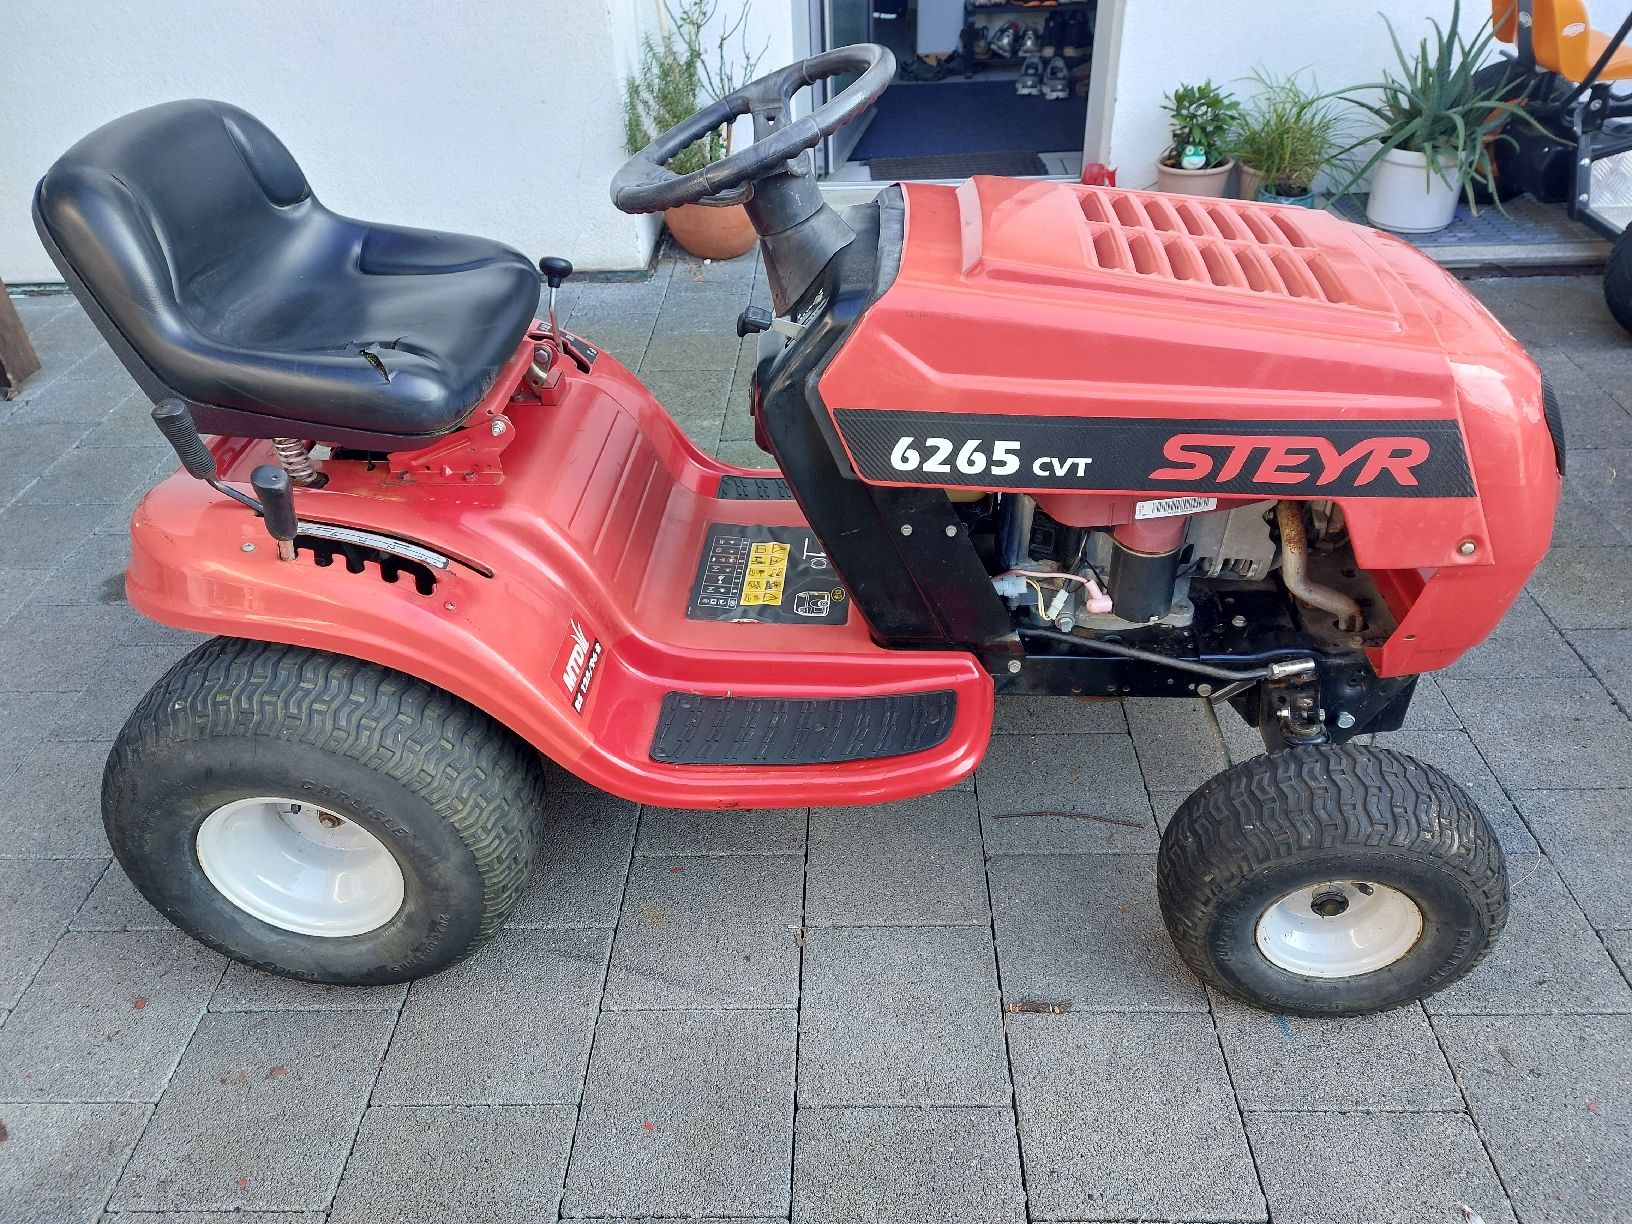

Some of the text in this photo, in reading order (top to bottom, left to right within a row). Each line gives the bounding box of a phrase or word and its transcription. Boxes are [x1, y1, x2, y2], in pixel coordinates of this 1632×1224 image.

[890, 436, 1092, 478] 6265 CVT
[1148, 433, 1431, 486] STEYR
[562, 643, 585, 693] MTD
[301, 779, 410, 837] CARLISLE
